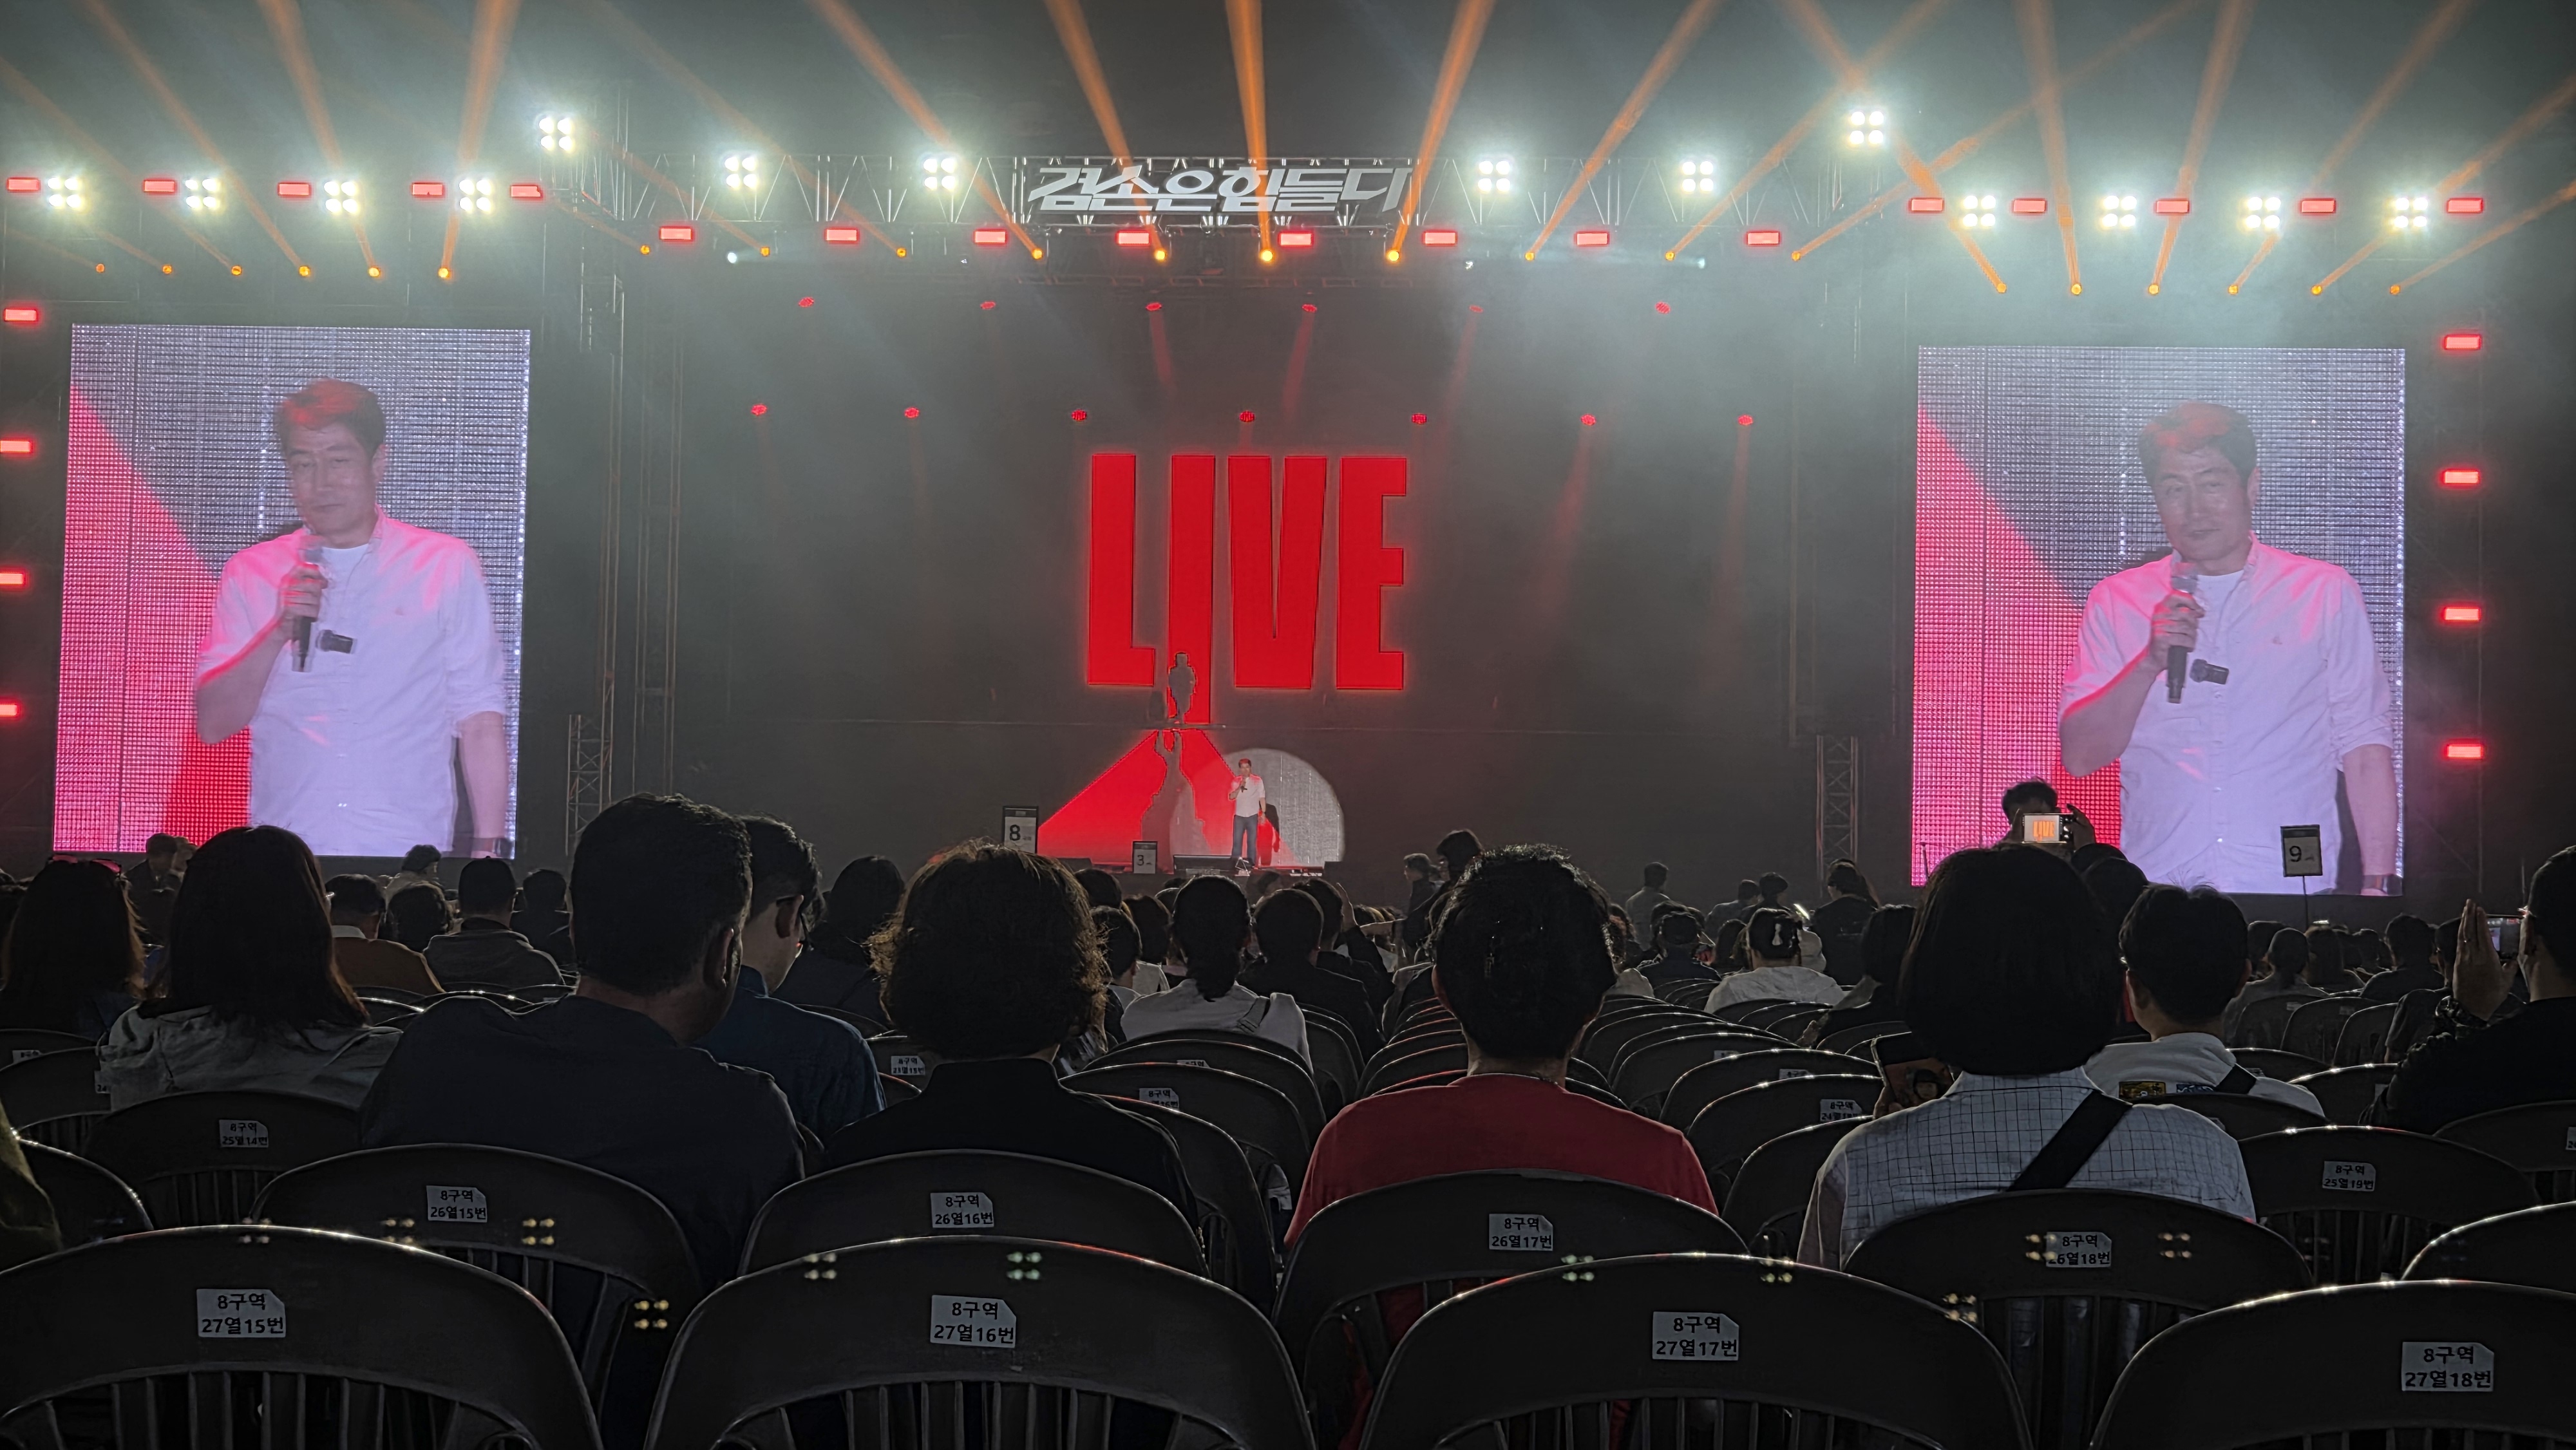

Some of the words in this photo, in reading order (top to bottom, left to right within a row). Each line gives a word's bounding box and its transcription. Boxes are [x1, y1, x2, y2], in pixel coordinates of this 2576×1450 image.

[1087, 454, 1407, 724] LIVE
[1009, 824, 1021, 842] 8
[1137, 854, 1144, 866] 3
[2289, 845, 2302, 862] 9
[1830, 1101, 1853, 1109] 8구역
[230, 1122, 257, 1134] 8구역
[2335, 1165, 2365, 1175] 8구역
[440, 1190, 473, 1202] 8구역
[945, 1194, 979, 1207] 8구역
[430, 1206, 486, 1219] 26열15번
[935, 1212, 993, 1225] 26열16번
[1504, 1217, 1539, 1232] 8구역
[1492, 1235, 1551, 1248] 26열17번
[2062, 1234, 2098, 1247] 8구역
[218, 1293, 265, 1310] 8구역
[952, 1302, 998, 1320] 8구역
[202, 1317, 283, 1335] 27열15번
[1673, 1316, 1720, 1333] 8구역
[934, 1324, 1014, 1344] 27열16번
[1656, 1339, 1737, 1357] 27열17번
[2423, 1346, 2474, 1364] 8구역
[2405, 1370, 2490, 1388] 27열18번
